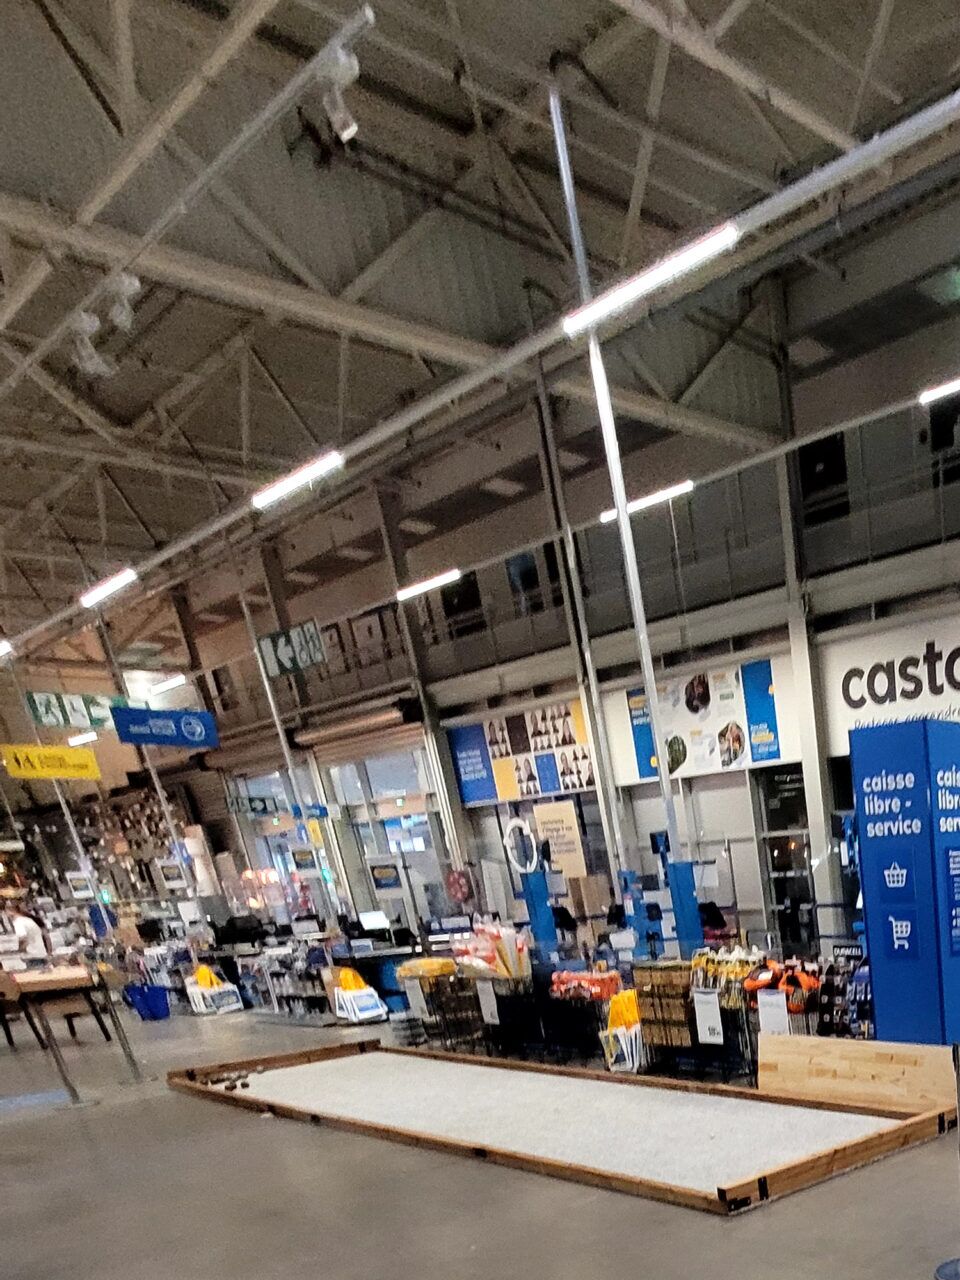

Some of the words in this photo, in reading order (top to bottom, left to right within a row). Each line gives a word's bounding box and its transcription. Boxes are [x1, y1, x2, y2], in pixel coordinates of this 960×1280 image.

[863, 769, 915, 793] caisse
[864, 793, 901, 816] libre
[867, 813, 922, 838] service
